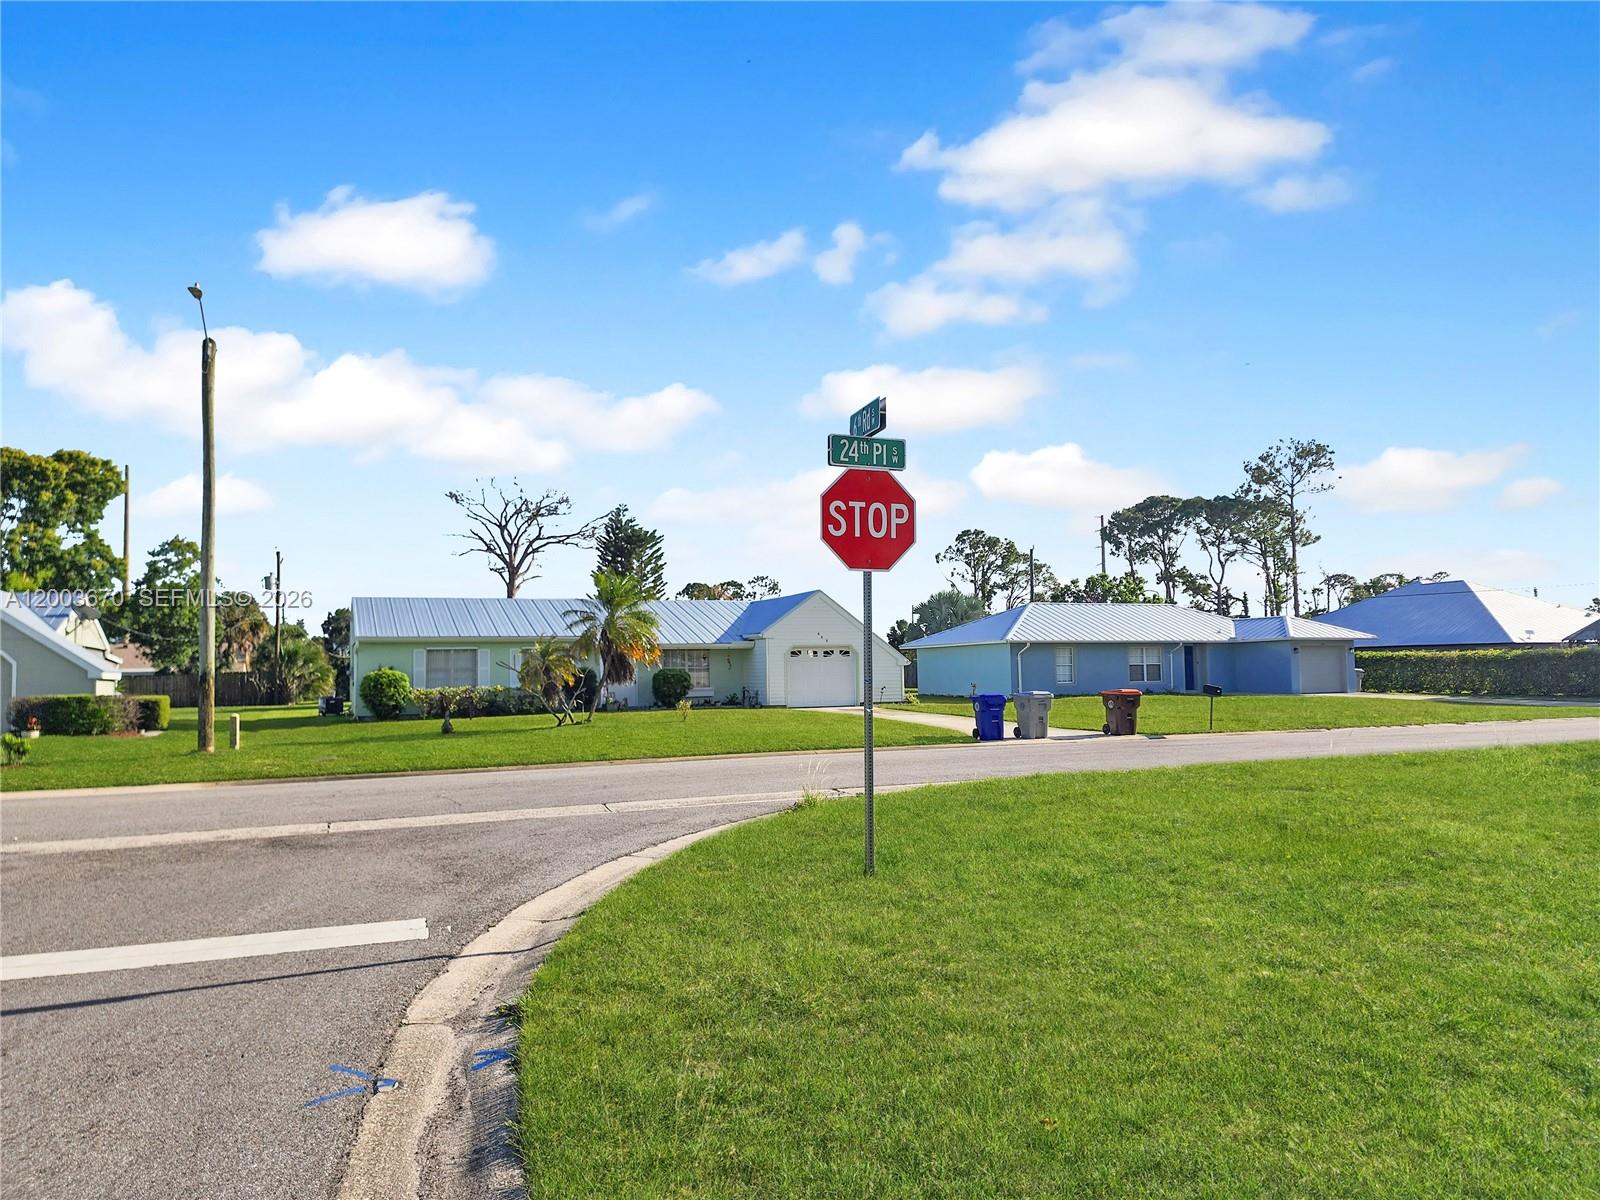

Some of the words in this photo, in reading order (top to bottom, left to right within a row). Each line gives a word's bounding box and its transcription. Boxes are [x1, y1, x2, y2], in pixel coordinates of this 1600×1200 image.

[862, 407, 871, 432] Rd
[840, 438, 869, 462] 24th
[873, 442, 887, 465] Pl
[827, 500, 910, 539] STOP
